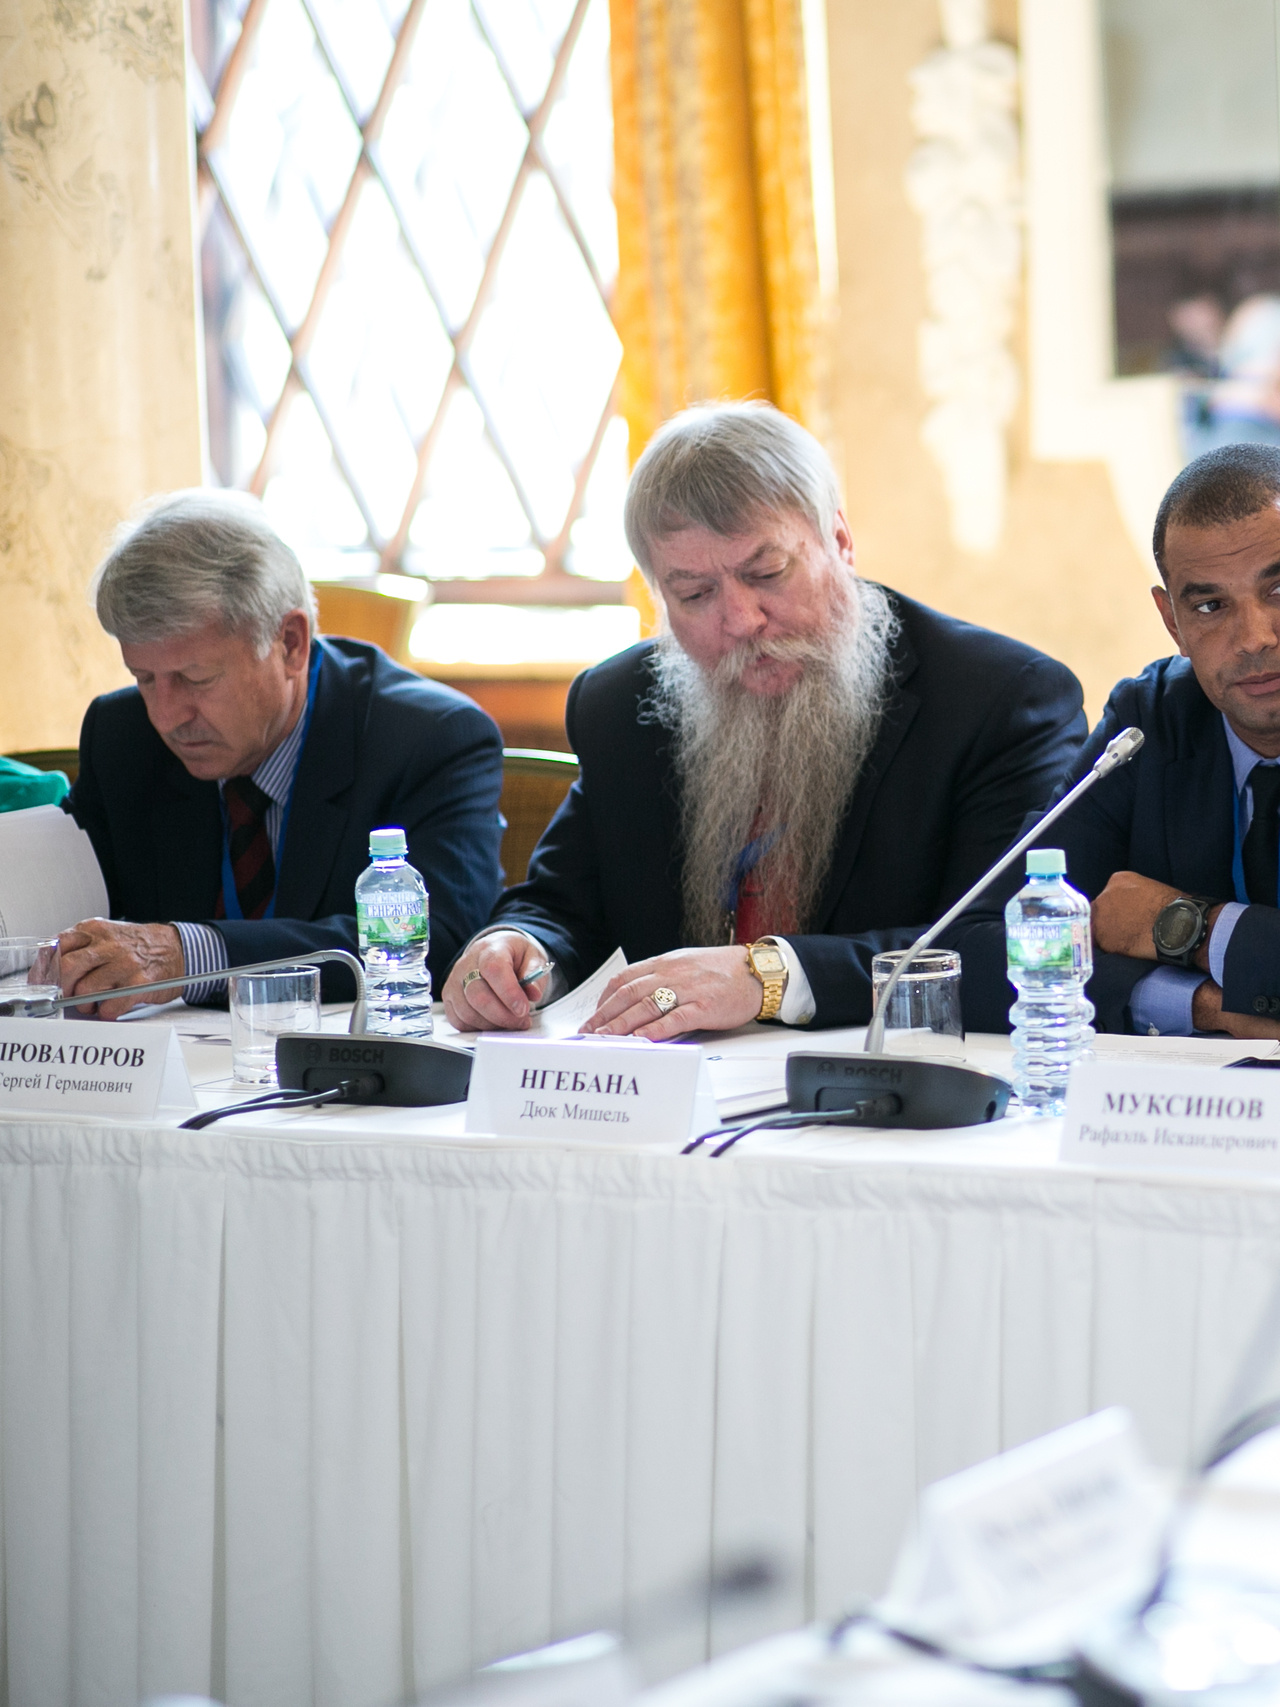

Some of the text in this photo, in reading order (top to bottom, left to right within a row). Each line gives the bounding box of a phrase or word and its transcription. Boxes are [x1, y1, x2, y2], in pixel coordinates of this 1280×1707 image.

[366, 901, 423, 918] СЕНЕЖСКАЯ
[329, 1047, 385, 1064] BOSCH
[45, 1073, 133, 1095] Германович
[519, 1068, 640, 1096] НГЕБАНА
[519, 1100, 630, 1124] Дюк Мишель
[1102, 1092, 1264, 1120] МУКСИНОВ
[1078, 1124, 1279, 1152] Рафаэль Искандерович
